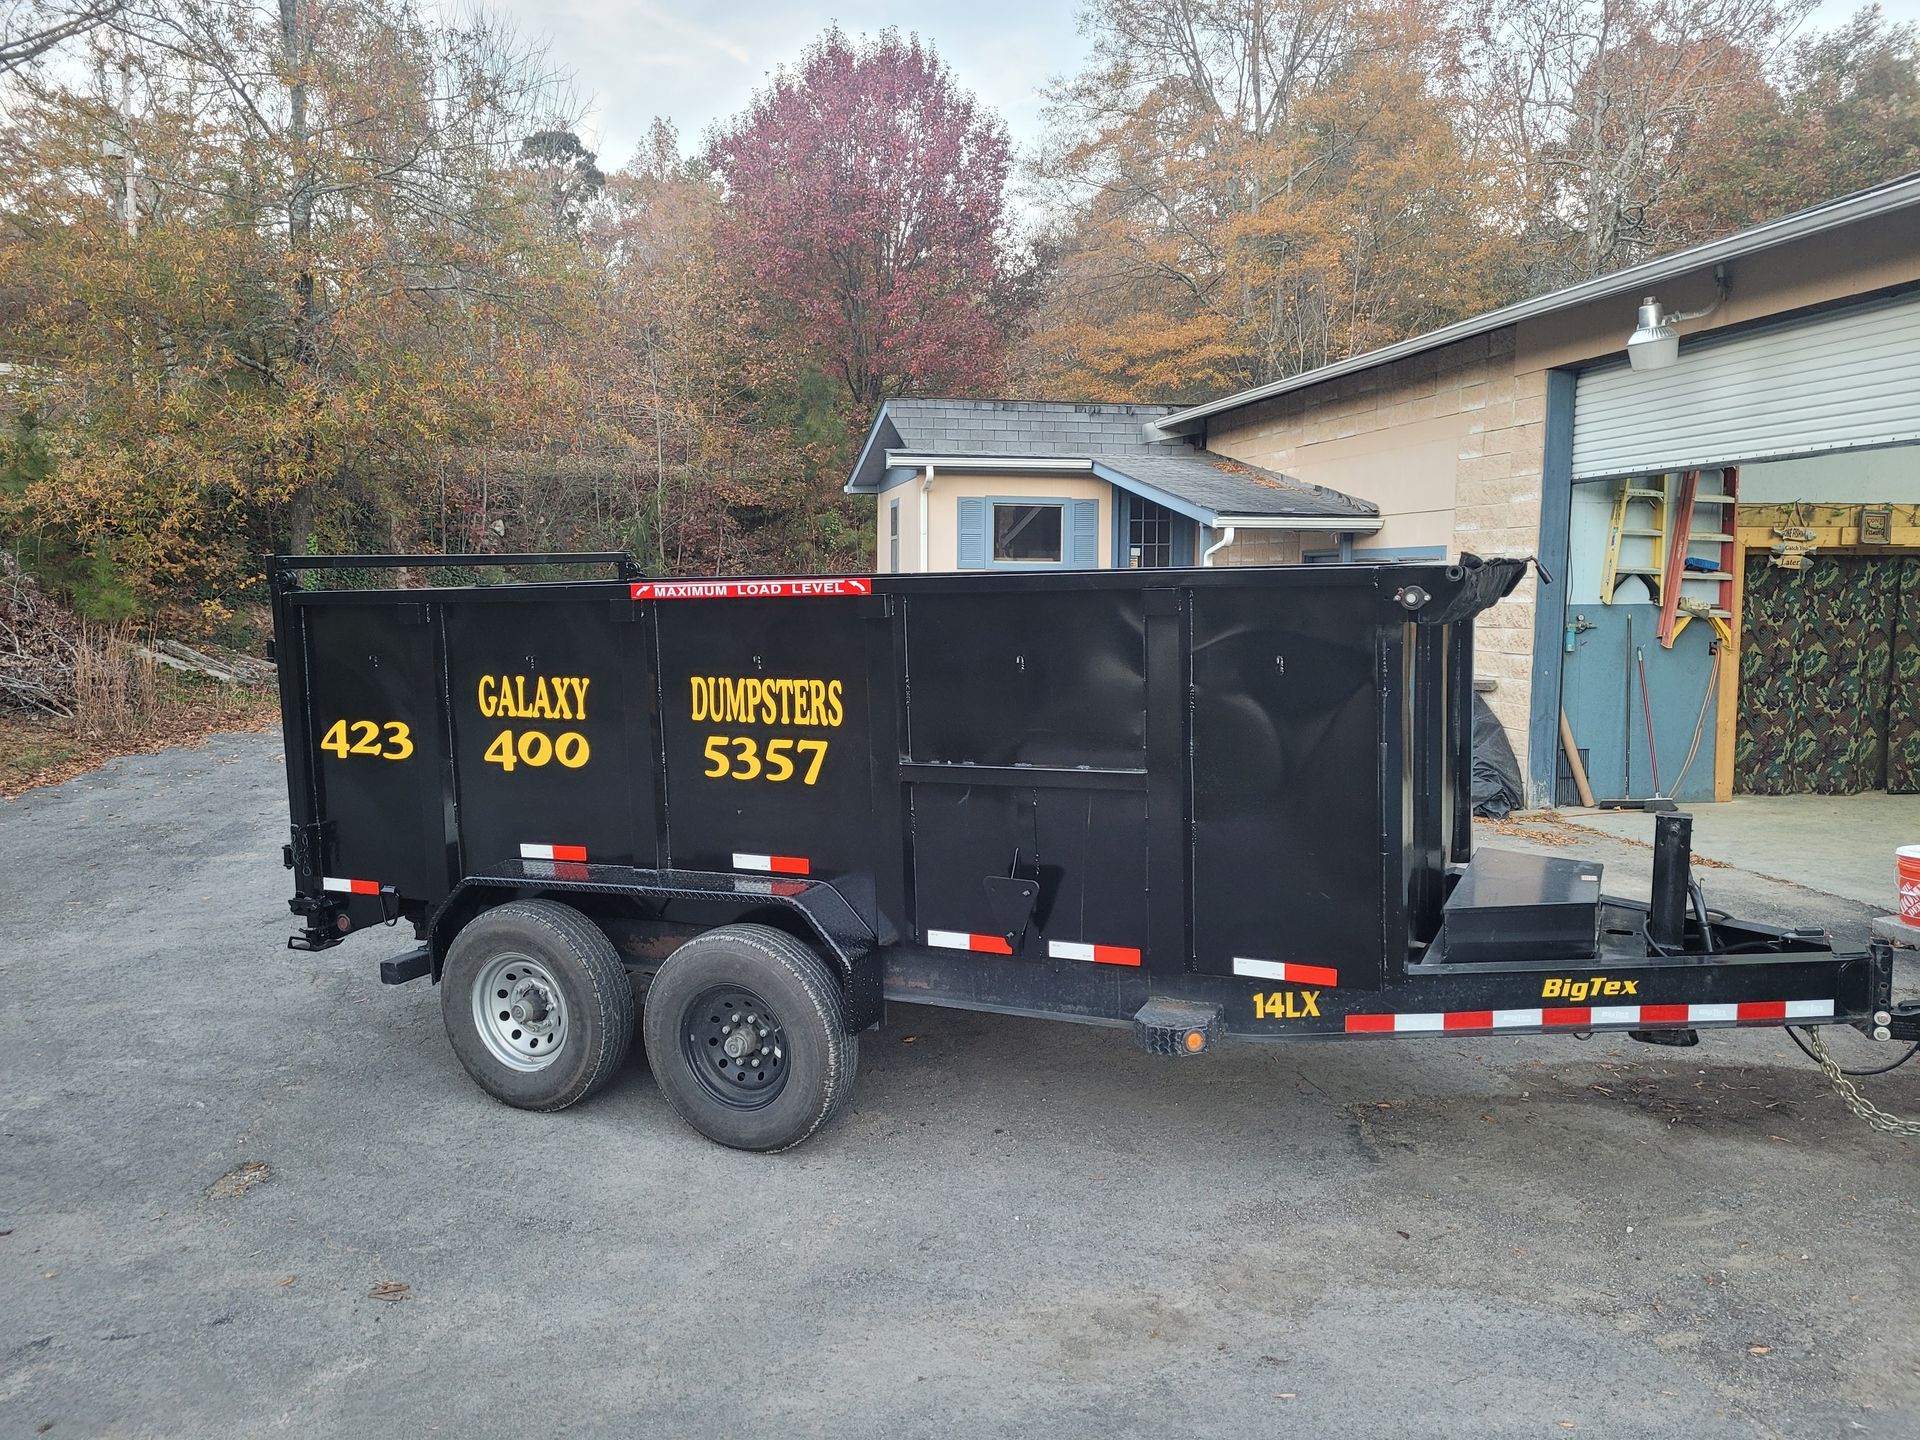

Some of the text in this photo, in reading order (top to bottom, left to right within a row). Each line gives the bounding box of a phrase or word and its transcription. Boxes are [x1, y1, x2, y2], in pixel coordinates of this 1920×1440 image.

[654, 583, 845, 597] MAXIMUM LOAD LEVEL
[478, 675, 844, 727] GALAXY DUMPSTERS
[320, 720, 829, 786] 423 400 5357
[1541, 977, 1639, 1002] BigTex
[1253, 990, 1321, 1019] 14LX
